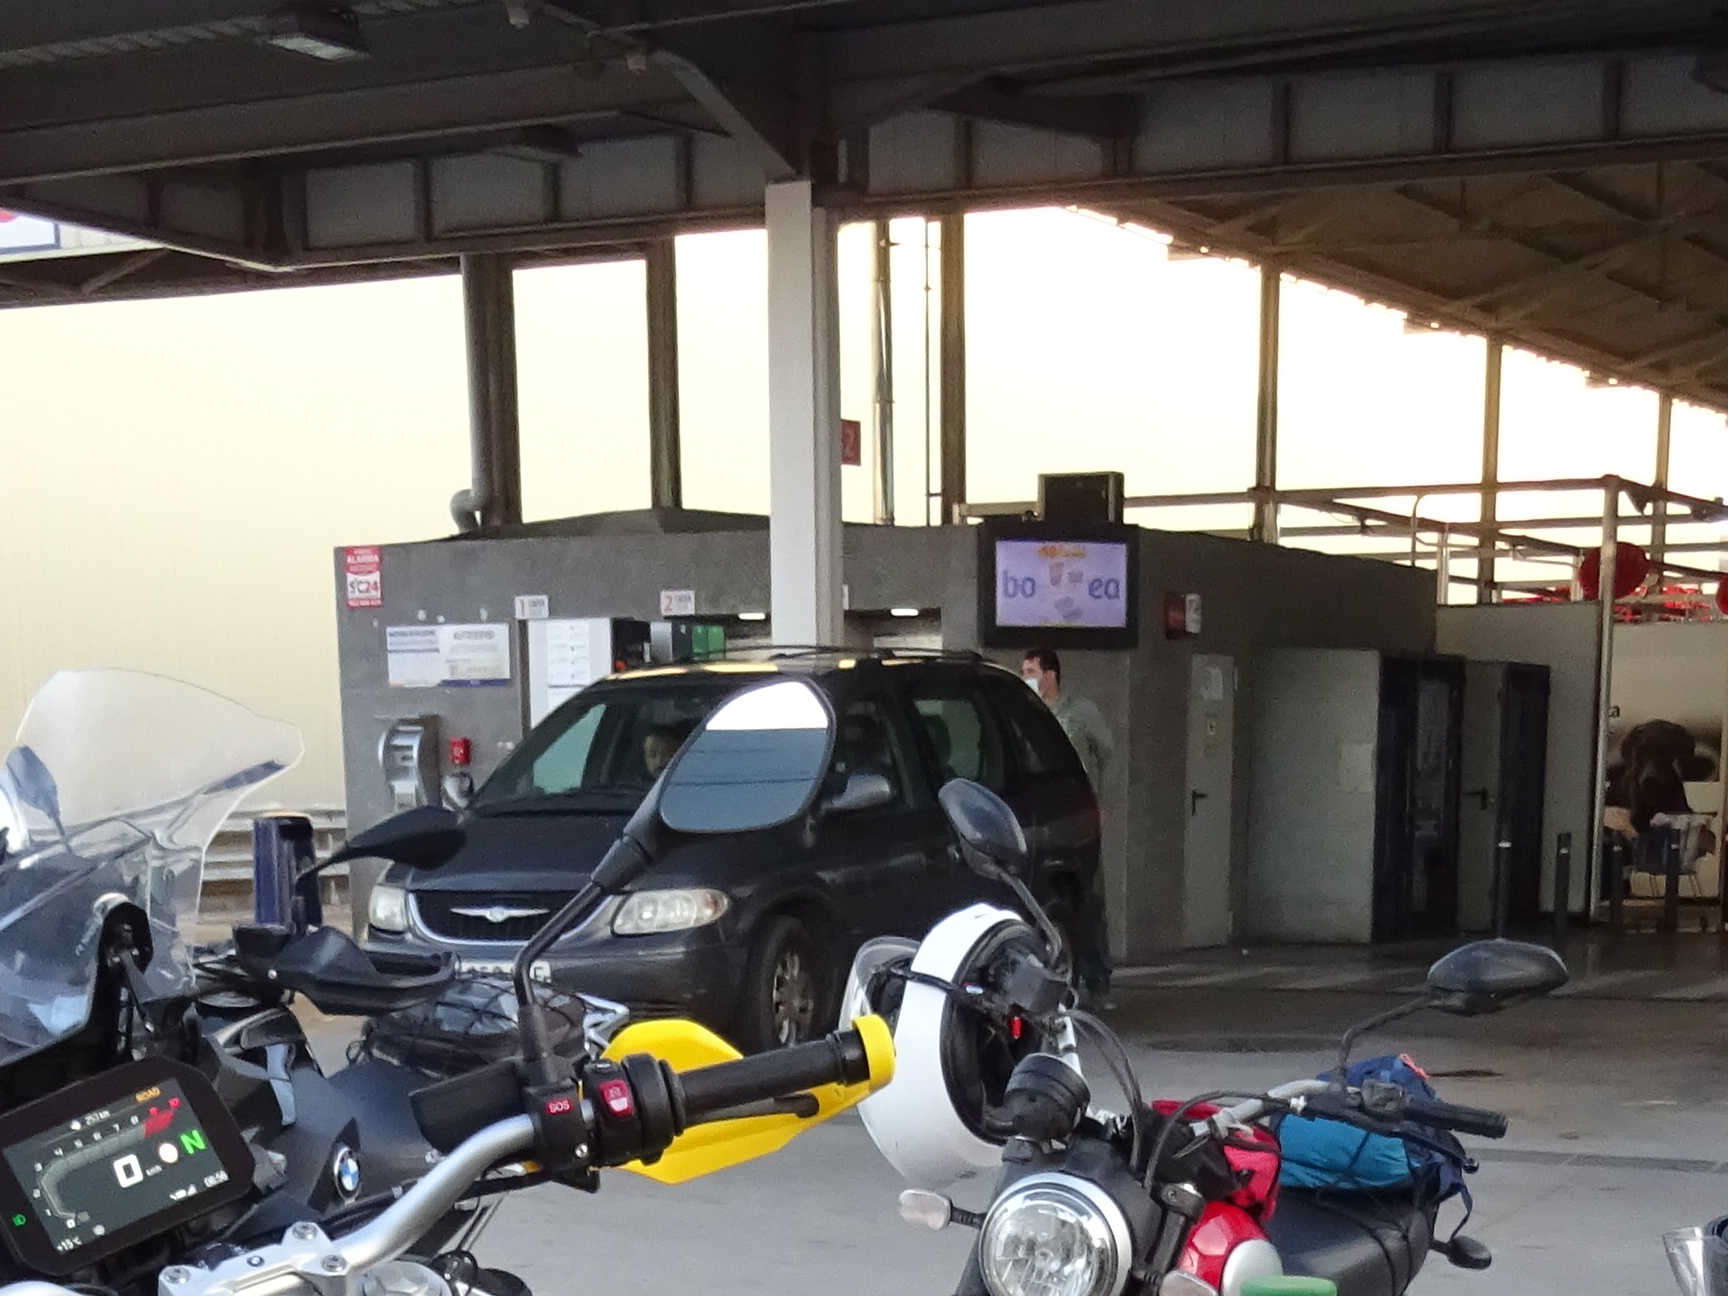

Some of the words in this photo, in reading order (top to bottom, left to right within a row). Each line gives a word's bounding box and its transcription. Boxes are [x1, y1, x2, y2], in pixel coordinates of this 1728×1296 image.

[135, 1086, 161, 1103] ROAD
[548, 1099, 571, 1113] SOS
[180, 1129, 206, 1154] N
[113, 1153, 144, 1188] 0
